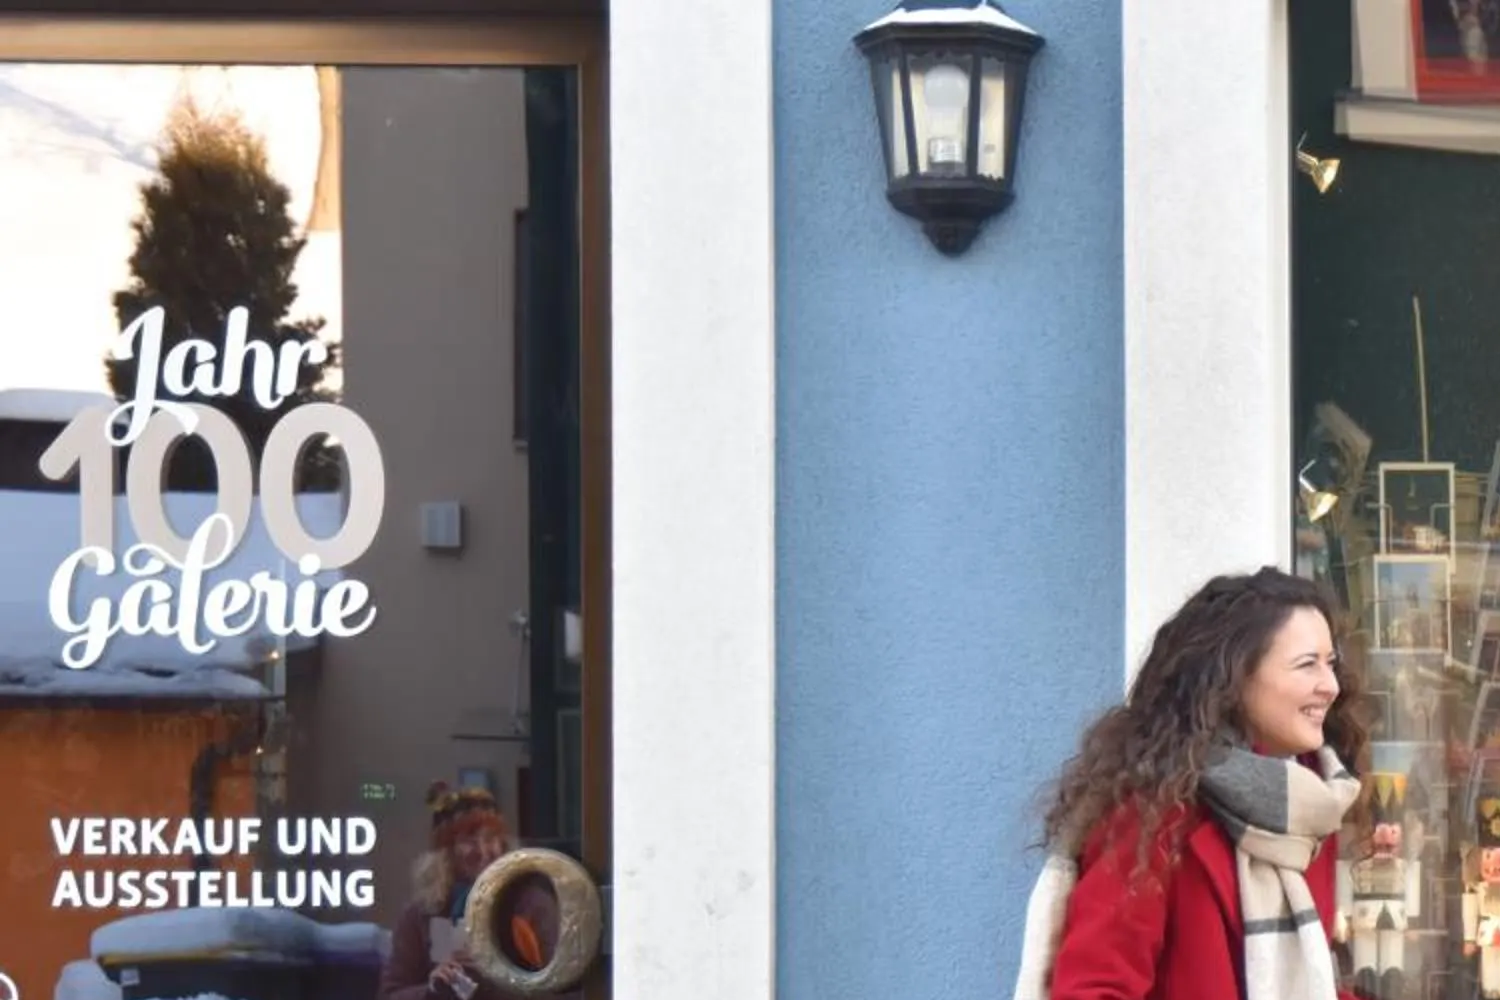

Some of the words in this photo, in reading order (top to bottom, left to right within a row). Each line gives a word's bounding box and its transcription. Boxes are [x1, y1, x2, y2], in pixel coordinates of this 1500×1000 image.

[105, 306, 328, 447] Jahr
[38, 402, 386, 569] 100
[48, 513, 377, 669] Galerie
[51, 818, 260, 855] VERKAUF
[277, 818, 377, 855] UND
[52, 870, 376, 908] AUSSTELLUNG
